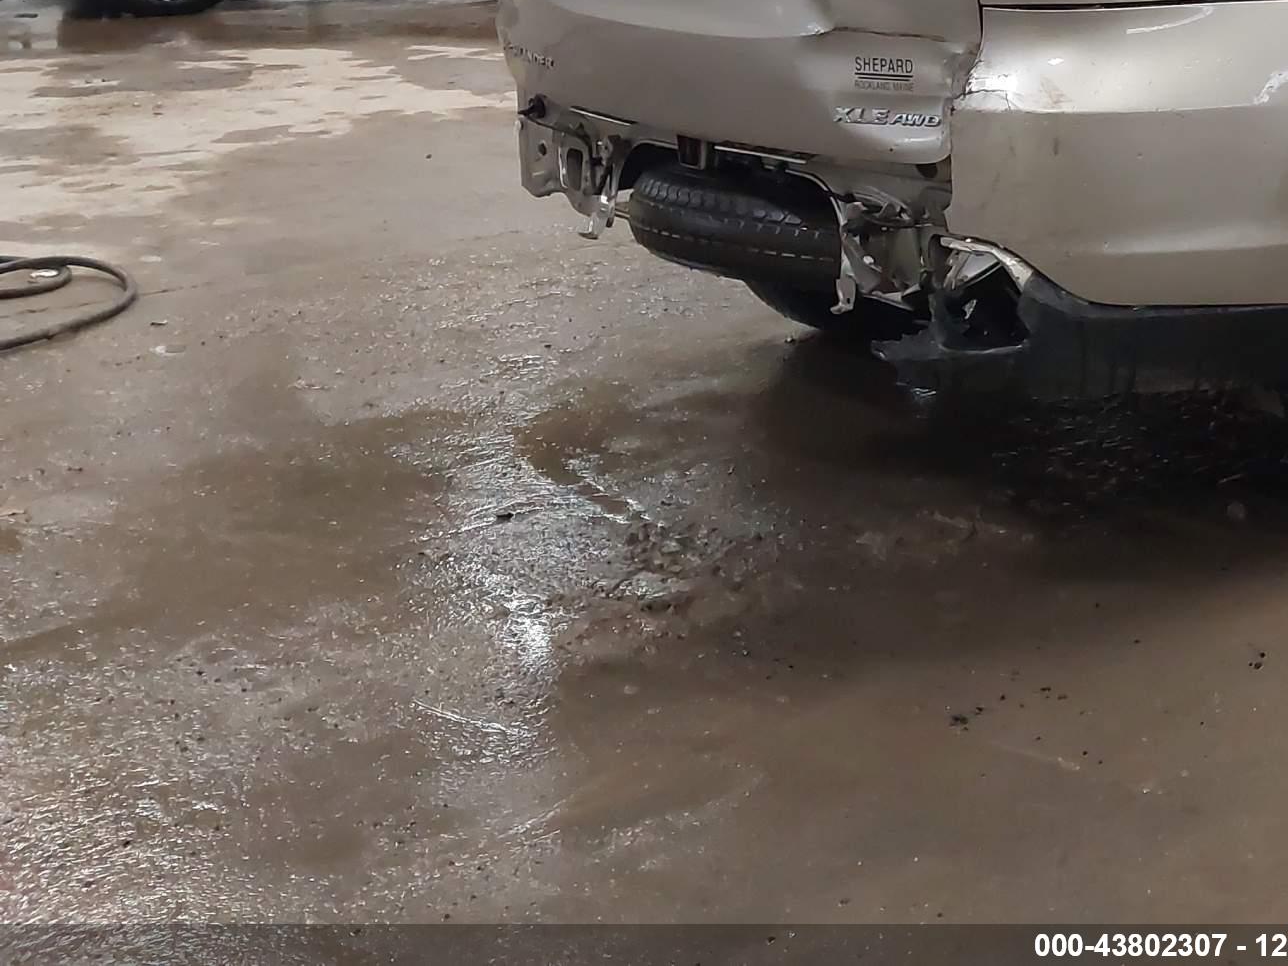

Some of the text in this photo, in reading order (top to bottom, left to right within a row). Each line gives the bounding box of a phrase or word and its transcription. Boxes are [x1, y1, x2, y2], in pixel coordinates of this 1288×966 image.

[854, 56, 914, 74] SHEPARD
[834, 106, 942, 127] XLE AWD
